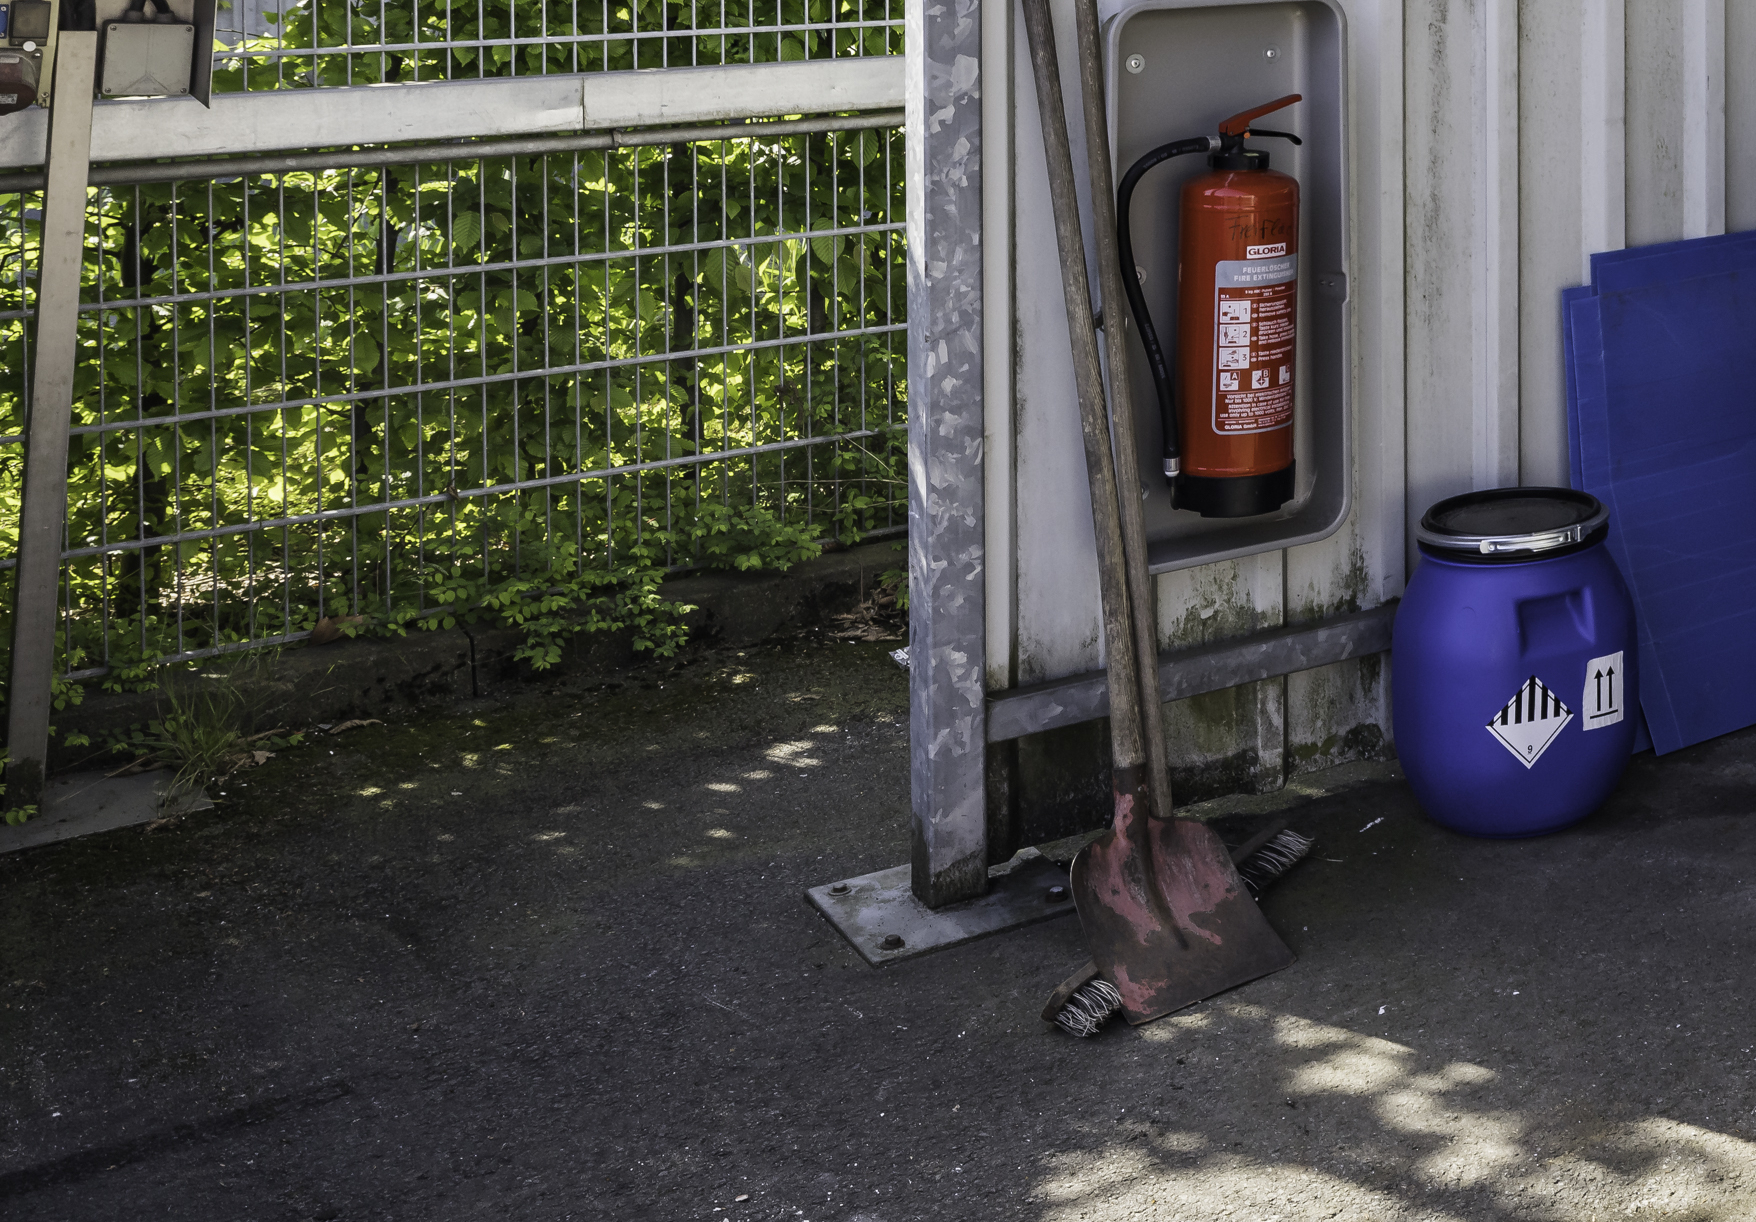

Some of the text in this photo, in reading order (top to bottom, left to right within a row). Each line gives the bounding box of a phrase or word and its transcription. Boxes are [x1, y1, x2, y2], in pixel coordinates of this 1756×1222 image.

[1248, 245, 1285, 255] GLORIA
[1243, 262, 1290, 273] FEUERLÖSCHER
[1528, 745, 1533, 753] 9
